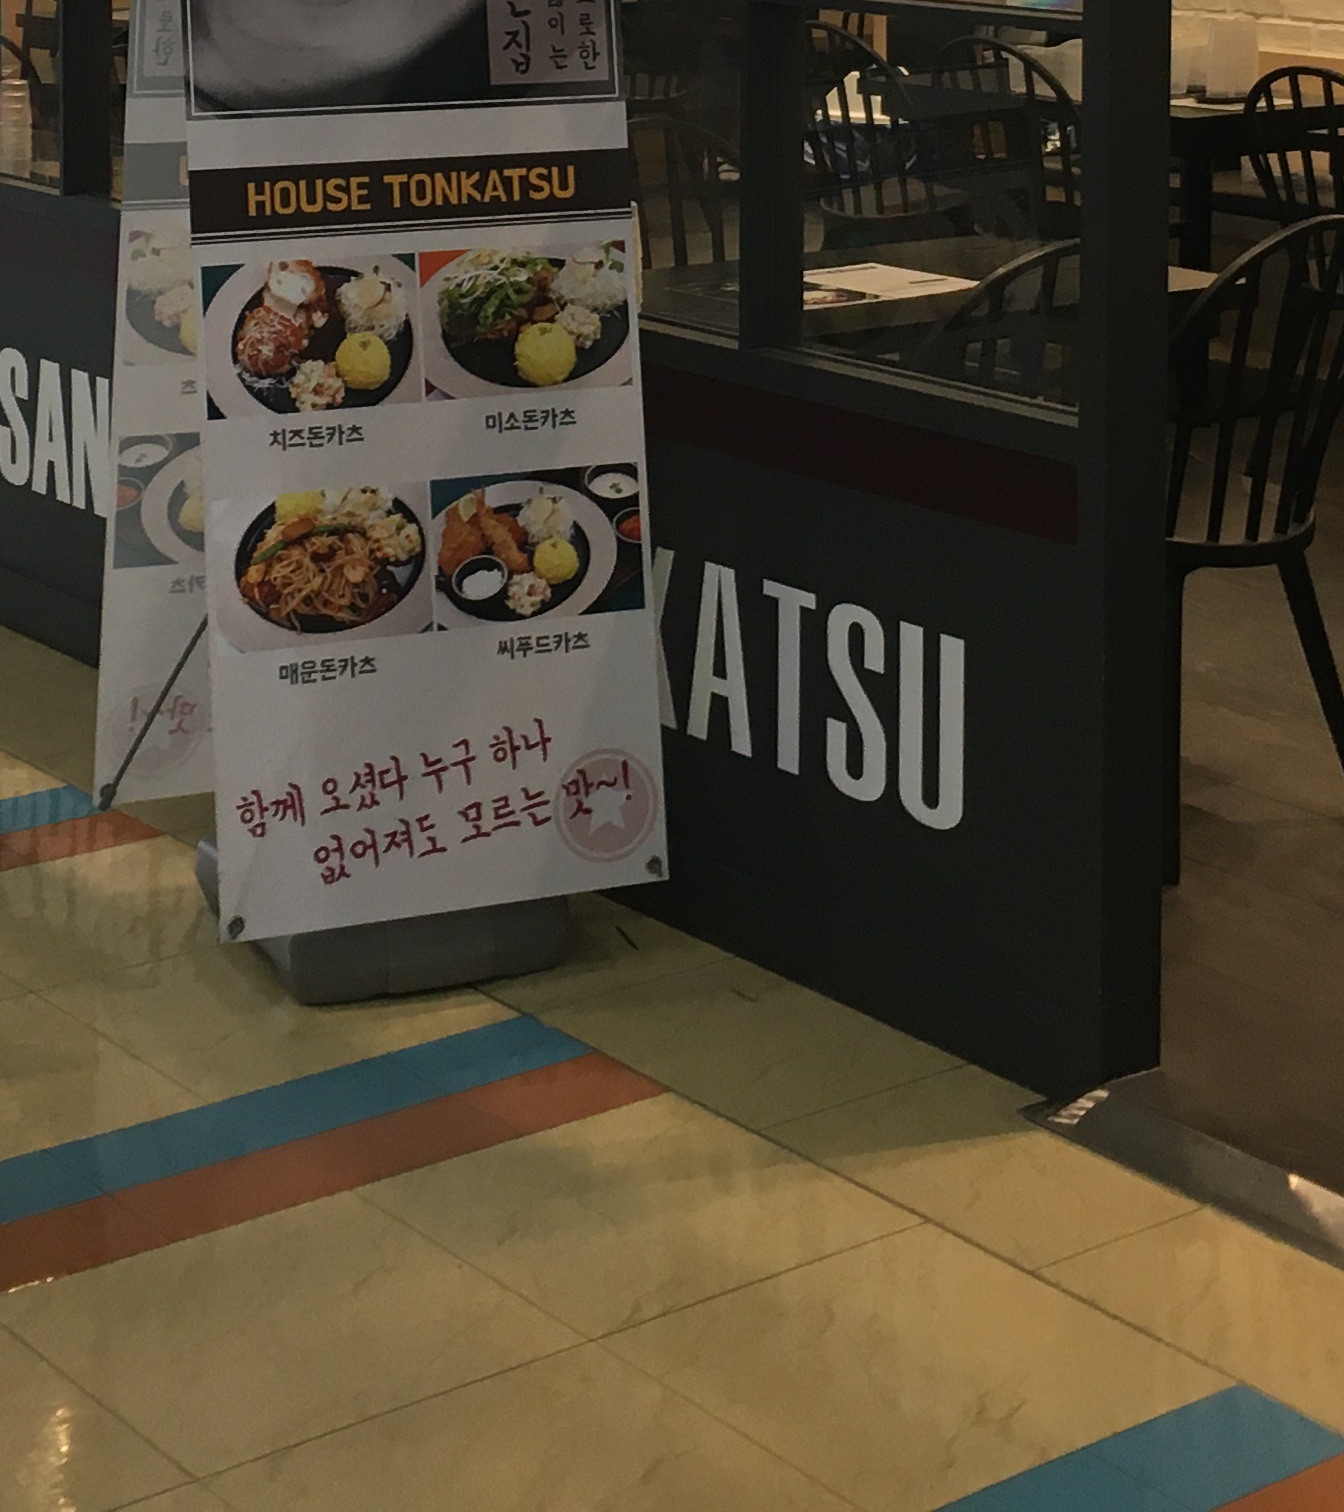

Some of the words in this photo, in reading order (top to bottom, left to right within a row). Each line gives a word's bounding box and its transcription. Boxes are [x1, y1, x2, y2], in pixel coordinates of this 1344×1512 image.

[246, 176, 371, 217] HOUSE
[383, 165, 575, 208] TONKATSU
[485, 407, 577, 434] 미소돈카츠
[269, 424, 365, 451] 치즈돈카츠
[497, 631, 591, 660] 씨푸드카츠
[278, 656, 377, 685] 매운돈카츠
[236, 782, 306, 838] 함께
[320, 755, 409, 816] 오셨다
[419, 739, 476, 794] 누구
[488, 717, 552, 770] 하나
[313, 813, 447, 886] 없어져도
[457, 787, 553, 843] 모르는
